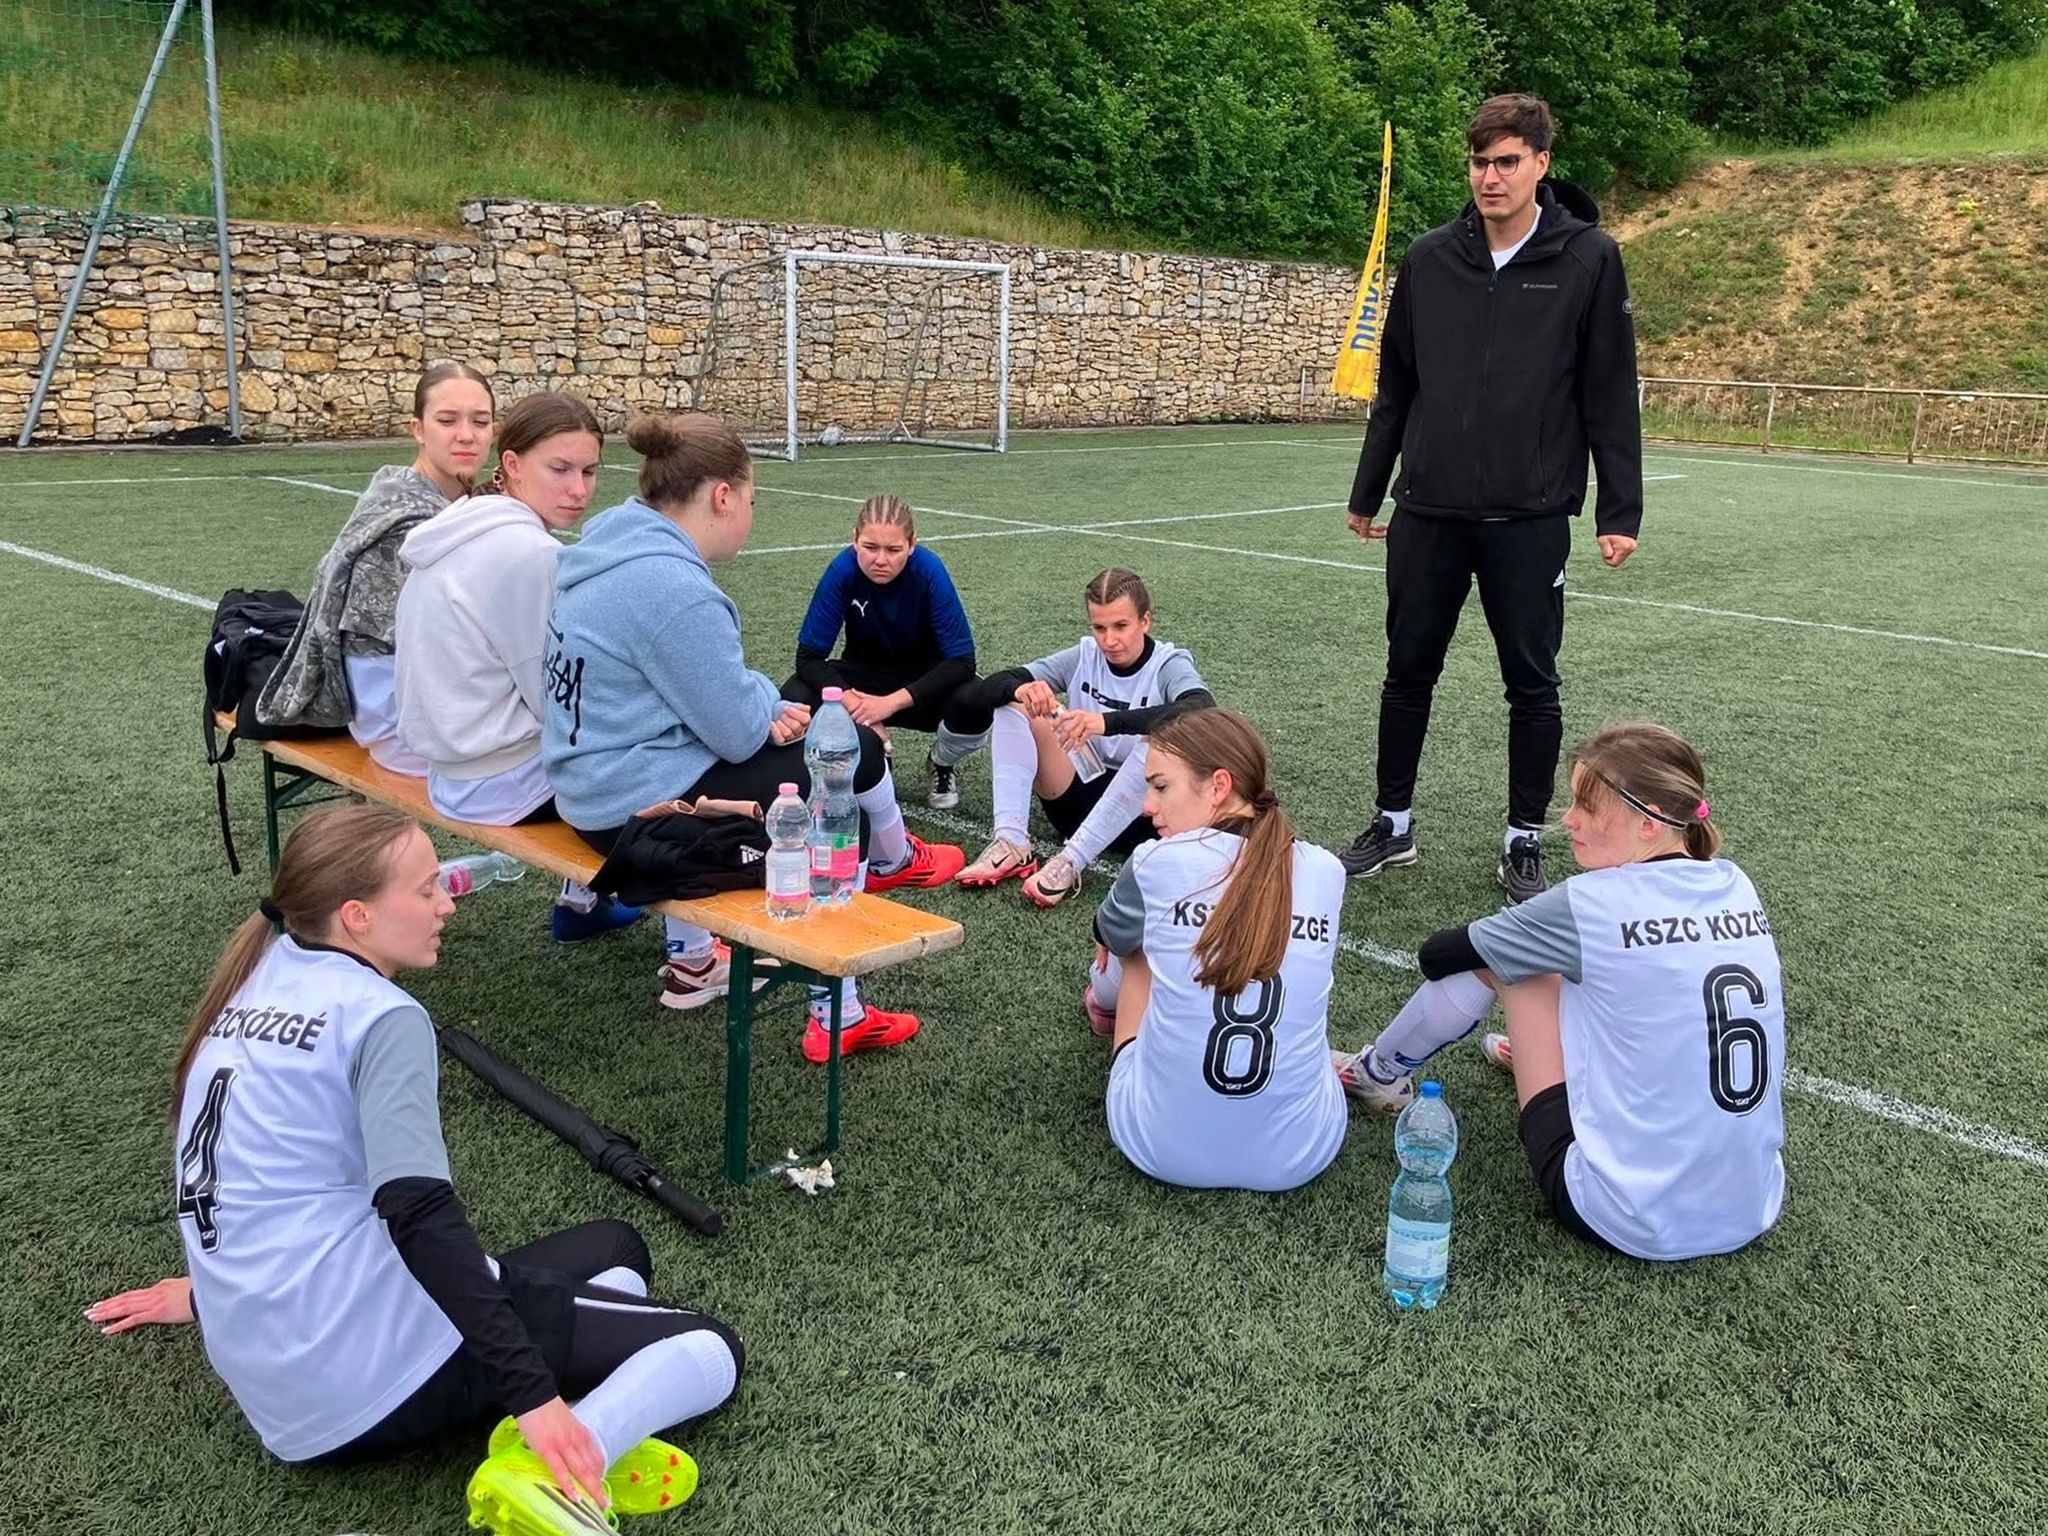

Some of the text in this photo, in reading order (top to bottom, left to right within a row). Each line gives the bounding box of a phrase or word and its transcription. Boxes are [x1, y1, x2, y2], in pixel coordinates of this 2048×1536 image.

[1173, 901, 1330, 943] KS ZGÉ
[1620, 916, 1702, 949] KSZC
[1203, 970, 1287, 1100] 8
[1702, 963, 1772, 1118] 6
[177, 1067, 238, 1255] 4
